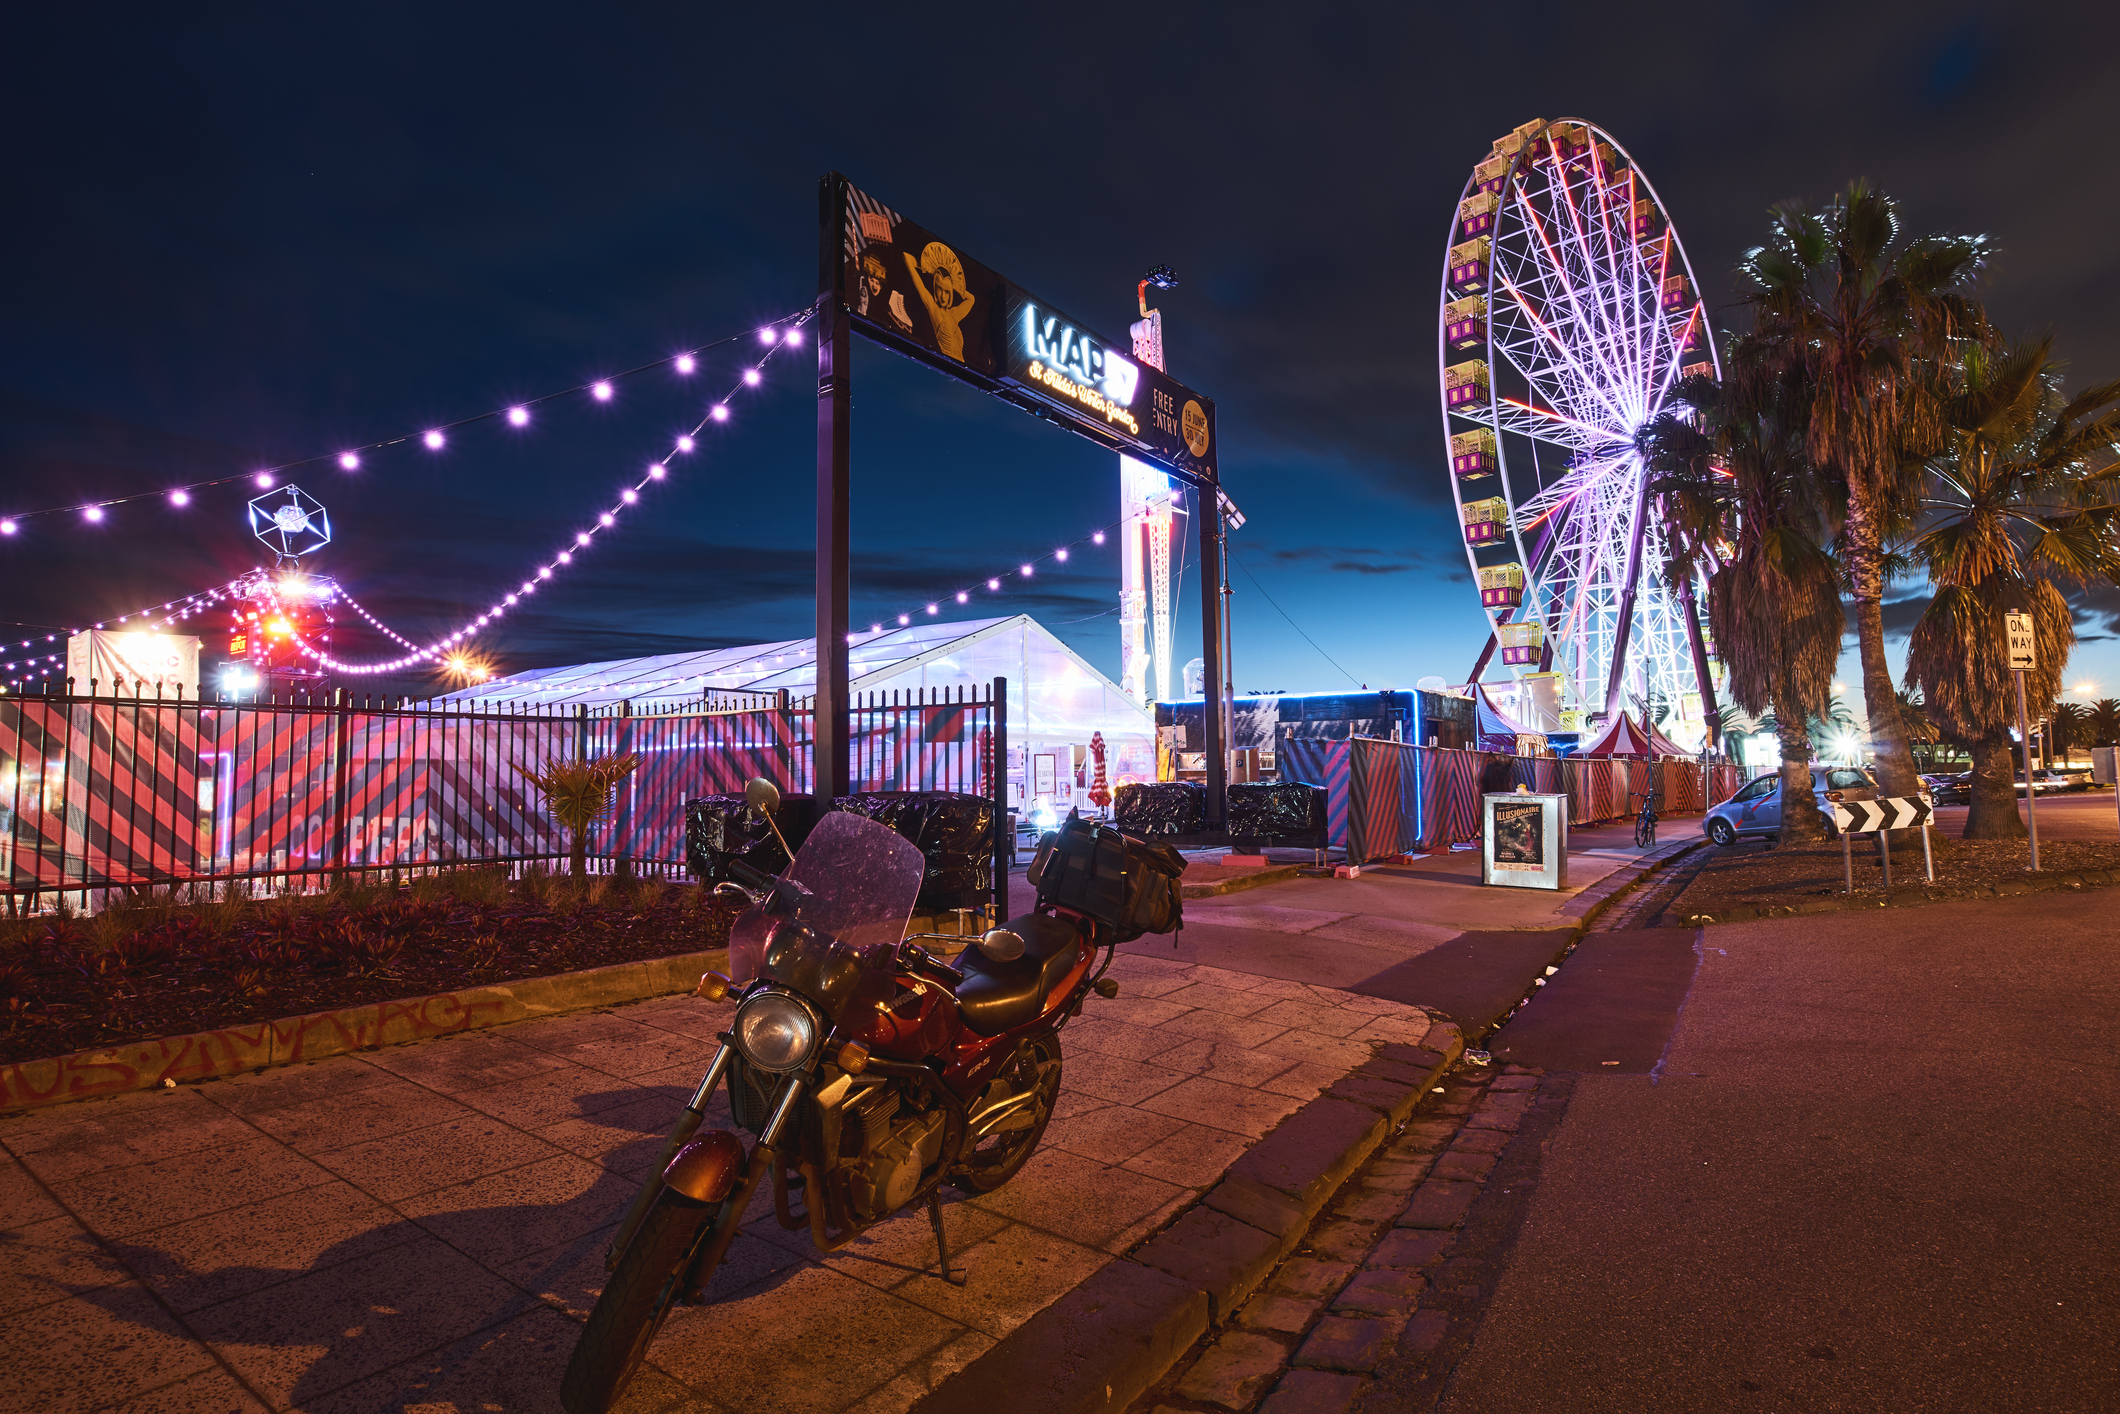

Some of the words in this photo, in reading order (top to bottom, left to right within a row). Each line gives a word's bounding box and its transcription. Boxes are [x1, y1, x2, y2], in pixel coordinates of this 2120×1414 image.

[1029, 360, 1043, 380] St
[1043, 368, 1078, 398] Kilda's
[1078, 384, 1106, 412] Winter
[1106, 400, 1139, 434] Garden
[1153, 388, 1174, 415] FREE
[1152, 407, 1178, 437] ENTRY
[1185, 409, 1192, 422] 15
[1192, 413, 1206, 430] JUNE
[1185, 428, 1194, 441] 30
[2010, 620, 2030, 632] ONE
[2010, 636, 2031, 649] WAY
[1496, 806, 1540, 821] ILLUSIONAIRE
